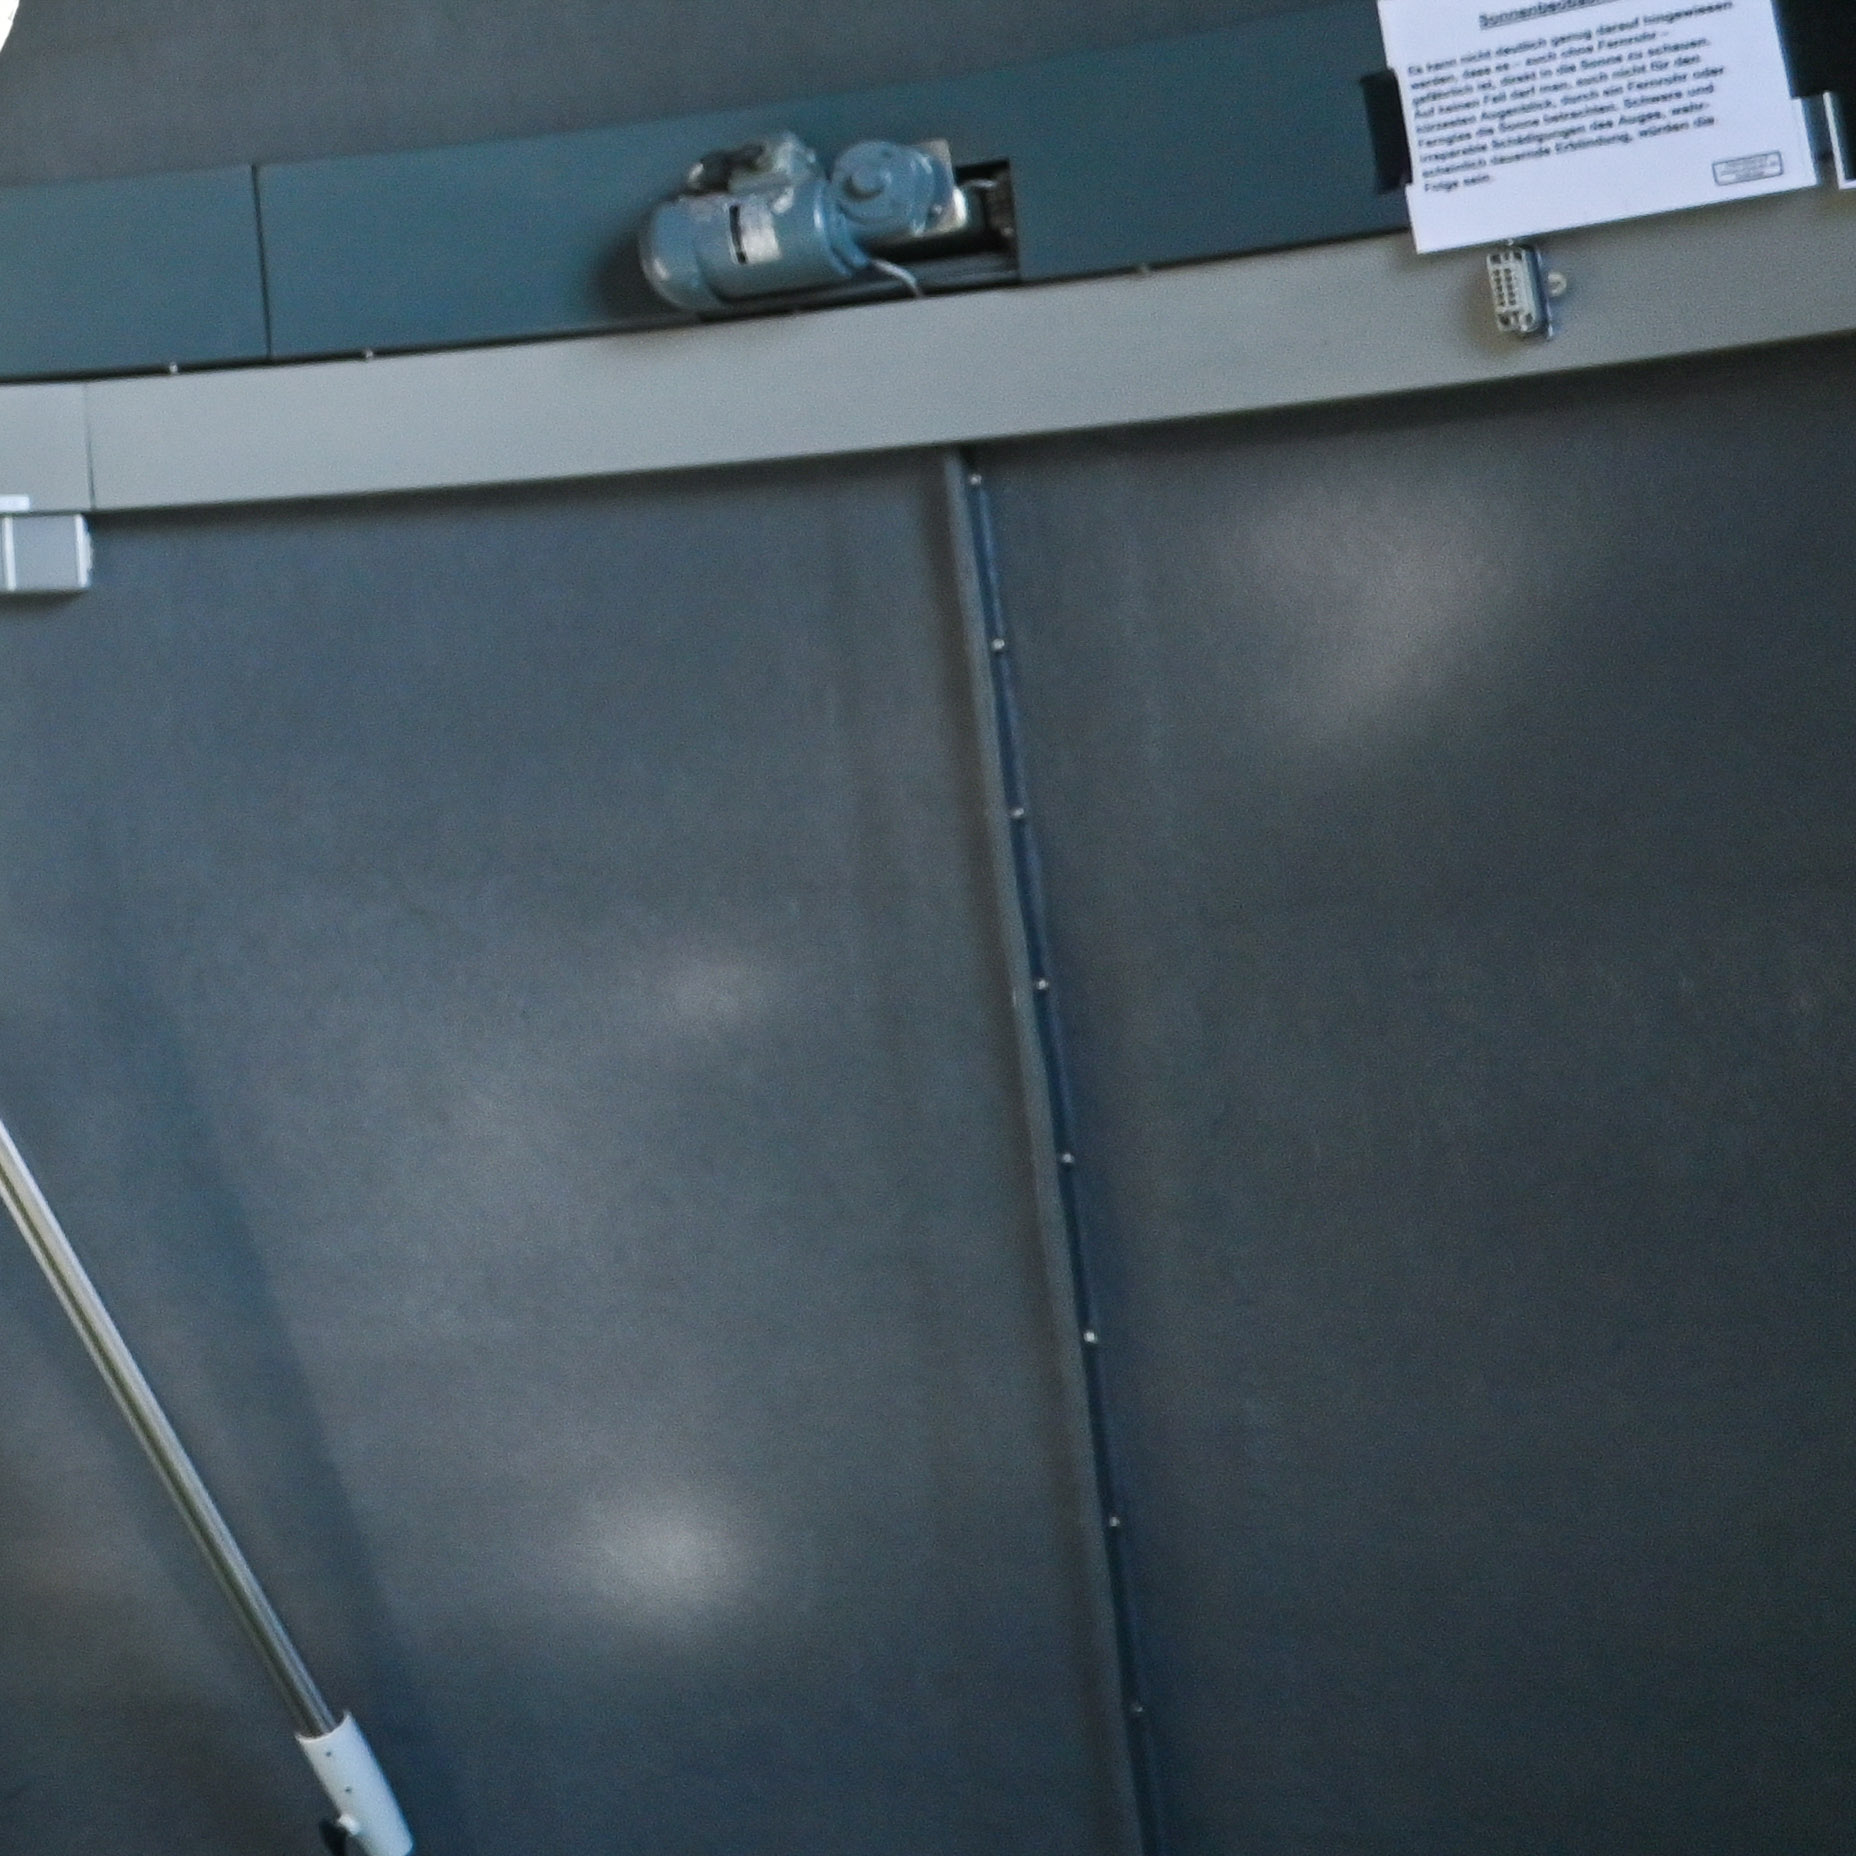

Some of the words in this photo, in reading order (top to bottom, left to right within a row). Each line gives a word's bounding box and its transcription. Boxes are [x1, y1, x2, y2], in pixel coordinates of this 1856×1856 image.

[1425, 58, 1457, 72] kann
[1459, 49, 1492, 64] nicht
[1493, 37, 1547, 57] deutlich
[1549, 28, 1592, 48] genug
[1594, 16, 1640, 36] darauf
[1642, 0, 1733, 26] hingewiesen
[1524, 51, 1557, 66] auch
[1559, 44, 1594, 59] ohne
[1596, 30, 1657, 51] Fernrohr
[1411, 84, 1474, 108] gefährlich
[1499, 70, 1537, 87] direkt
[1579, 53, 1624, 70] Sonne
[1415, 114, 1477, 134] kürzesten
[1559, 89, 1600, 106] durch
[1626, 72, 1688, 91] Fernrohr
[1692, 65, 1725, 79] oder
[1437, 98, 1480, 115] keinen
[1482, 91, 1507, 105] Fall
[1509, 84, 1535, 100] darf
[1575, 71, 1609, 87] auch
[1611, 63, 1647, 79] nicht
[1417, 131, 1472, 148] Fernglas
[1497, 118, 1540, 133] Sonne
[1622, 89, 1683, 109] Schwere
[1419, 143, 1488, 163] irreparable
[1490, 124, 1586, 150] Schädigungen
[1421, 157, 1487, 178] scheinlich
[1489, 143, 1551, 166] dauernde
[1637, 120, 1690, 139] würden
[1423, 179, 1460, 193] Folge
